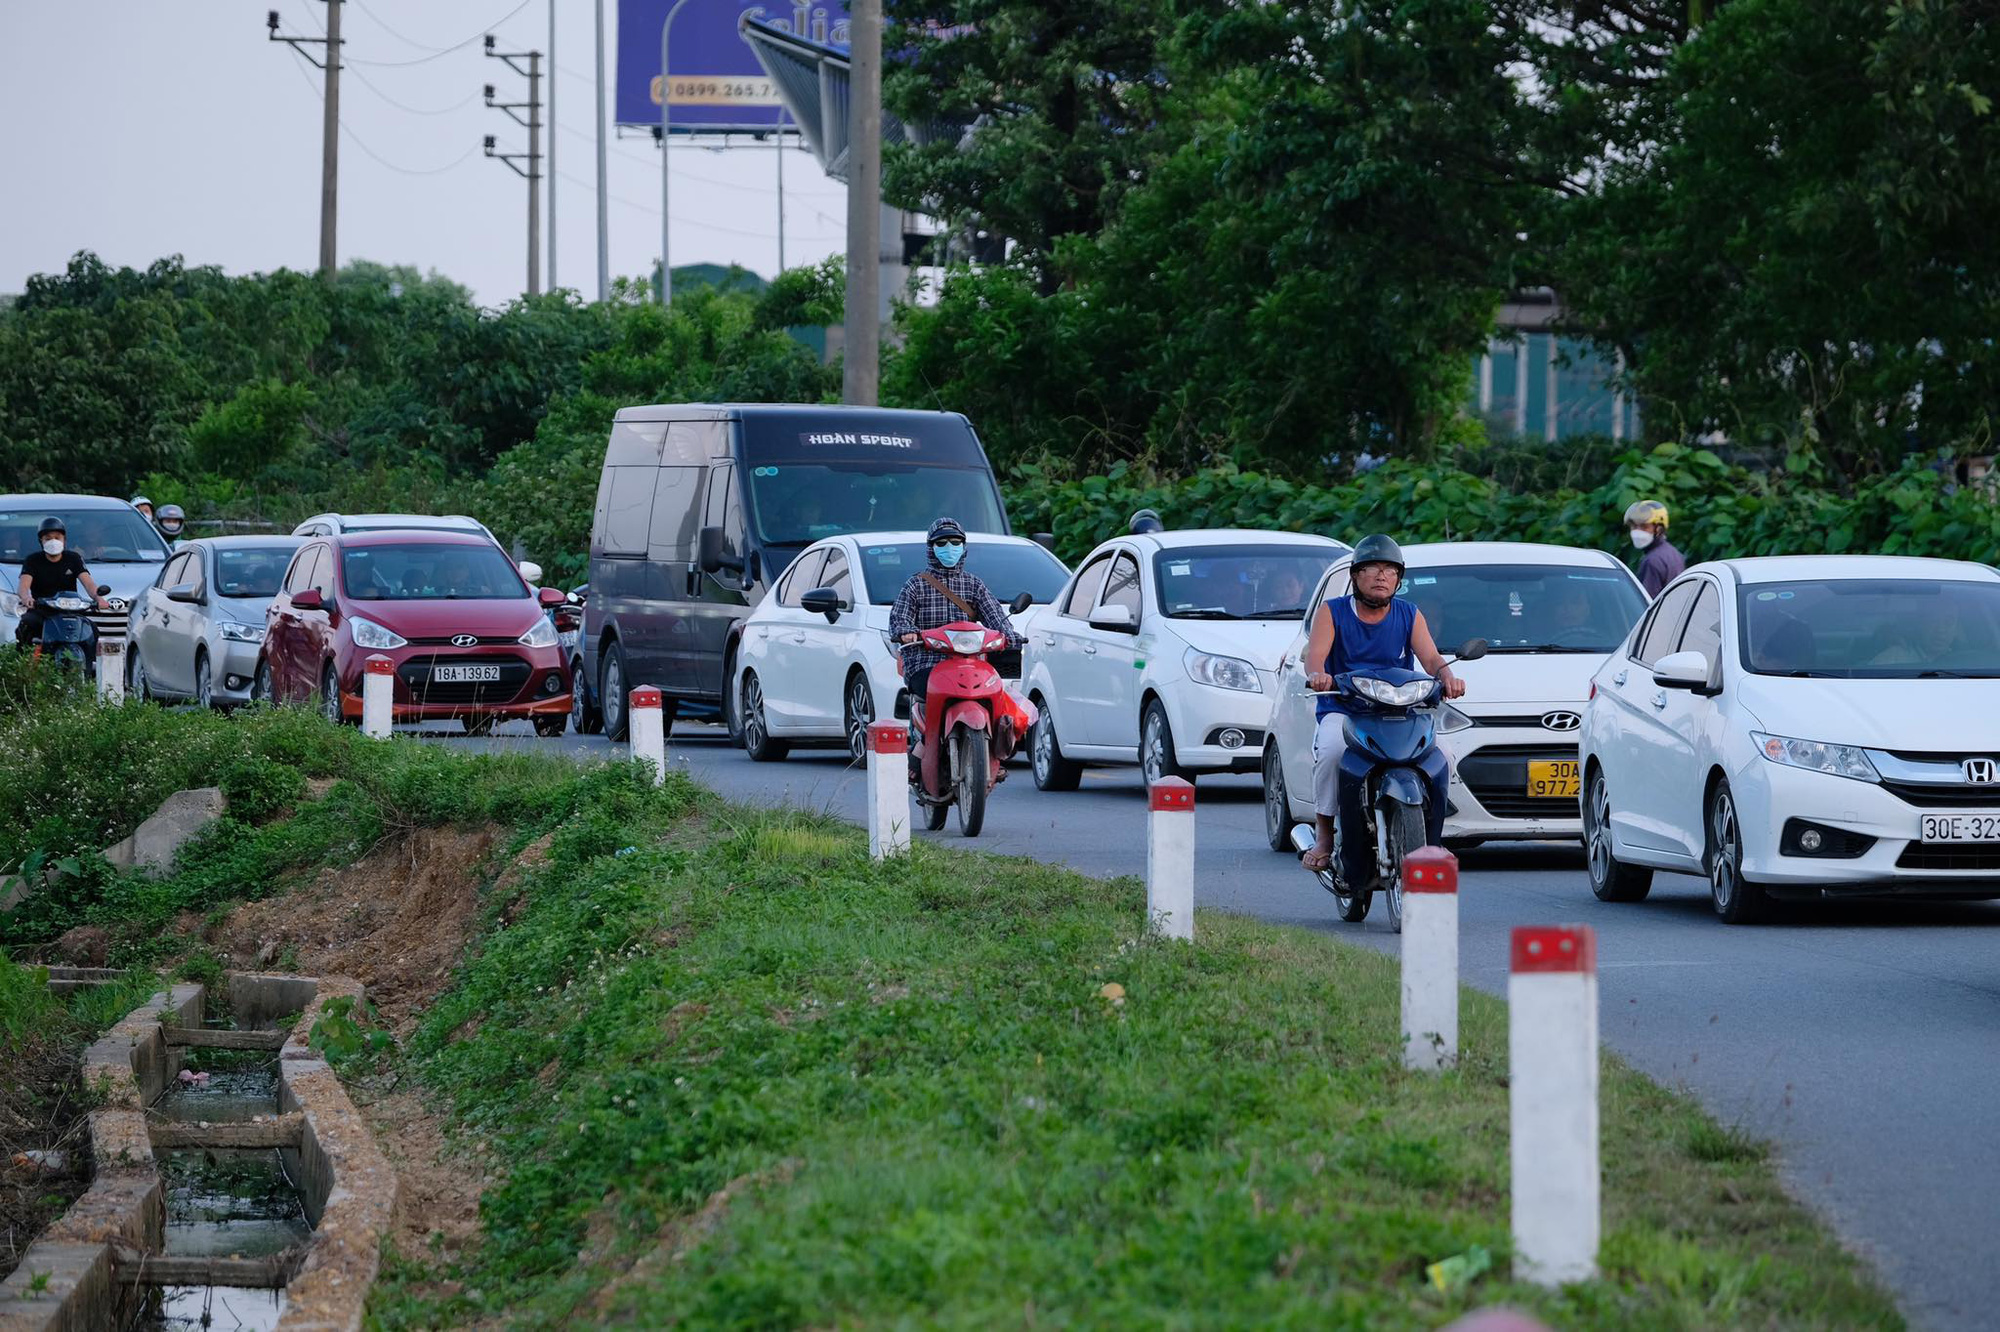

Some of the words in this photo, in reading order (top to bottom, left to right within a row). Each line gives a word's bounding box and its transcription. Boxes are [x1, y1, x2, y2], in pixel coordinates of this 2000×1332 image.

[860, 434, 913, 448] SPORT
[438, 667, 498, 680] 18A-139.62
[1550, 763, 1580, 778] 30A
